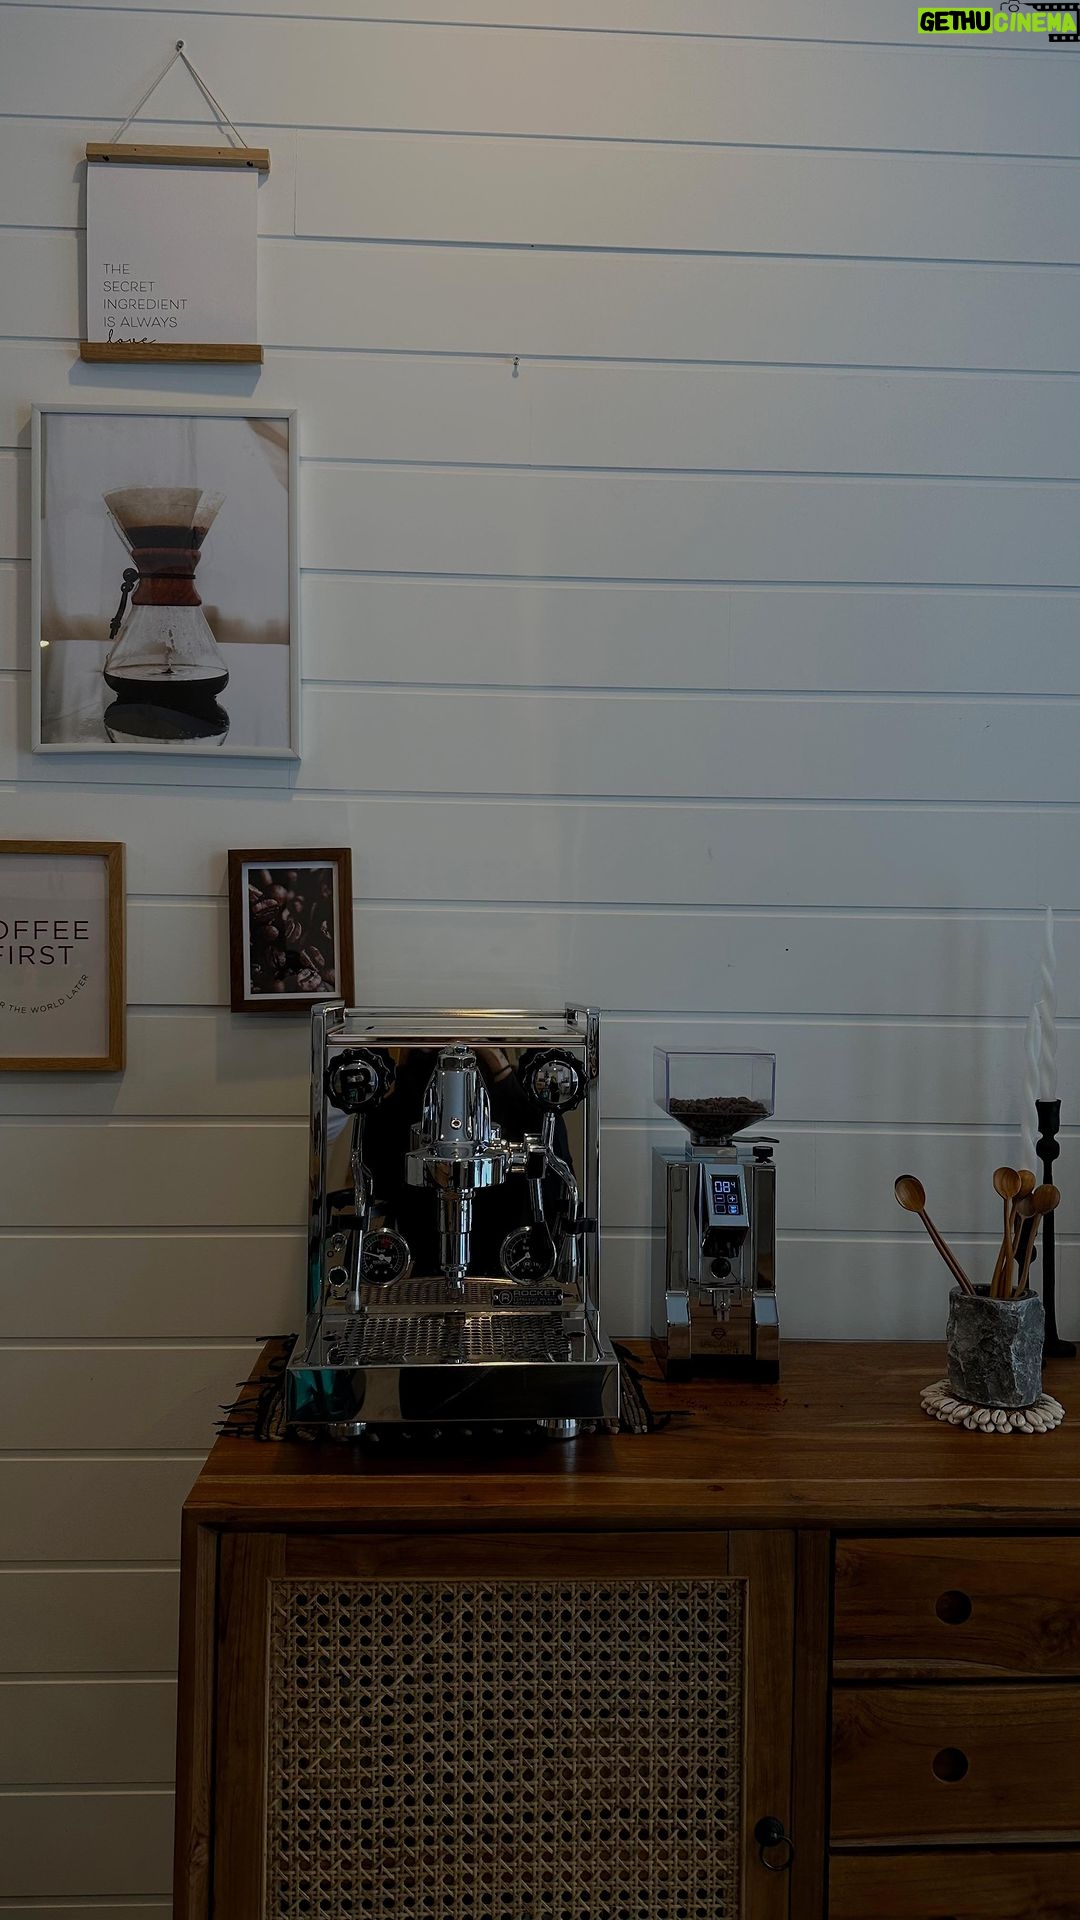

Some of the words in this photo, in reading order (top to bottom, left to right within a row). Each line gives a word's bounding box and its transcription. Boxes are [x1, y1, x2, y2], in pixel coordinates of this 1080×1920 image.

[103, 263, 130, 275] THE
[103, 281, 156, 292] SECRET
[103, 299, 188, 310] INGREDIENT
[103, 316, 115, 328] IS
[120, 316, 178, 328] ALWAYS
[0, 945, 74, 965] IRST
[9, 1004, 27, 1014] THE
[30, 998, 65, 1014] WORLD
[66, 974, 88, 1000] LATER
